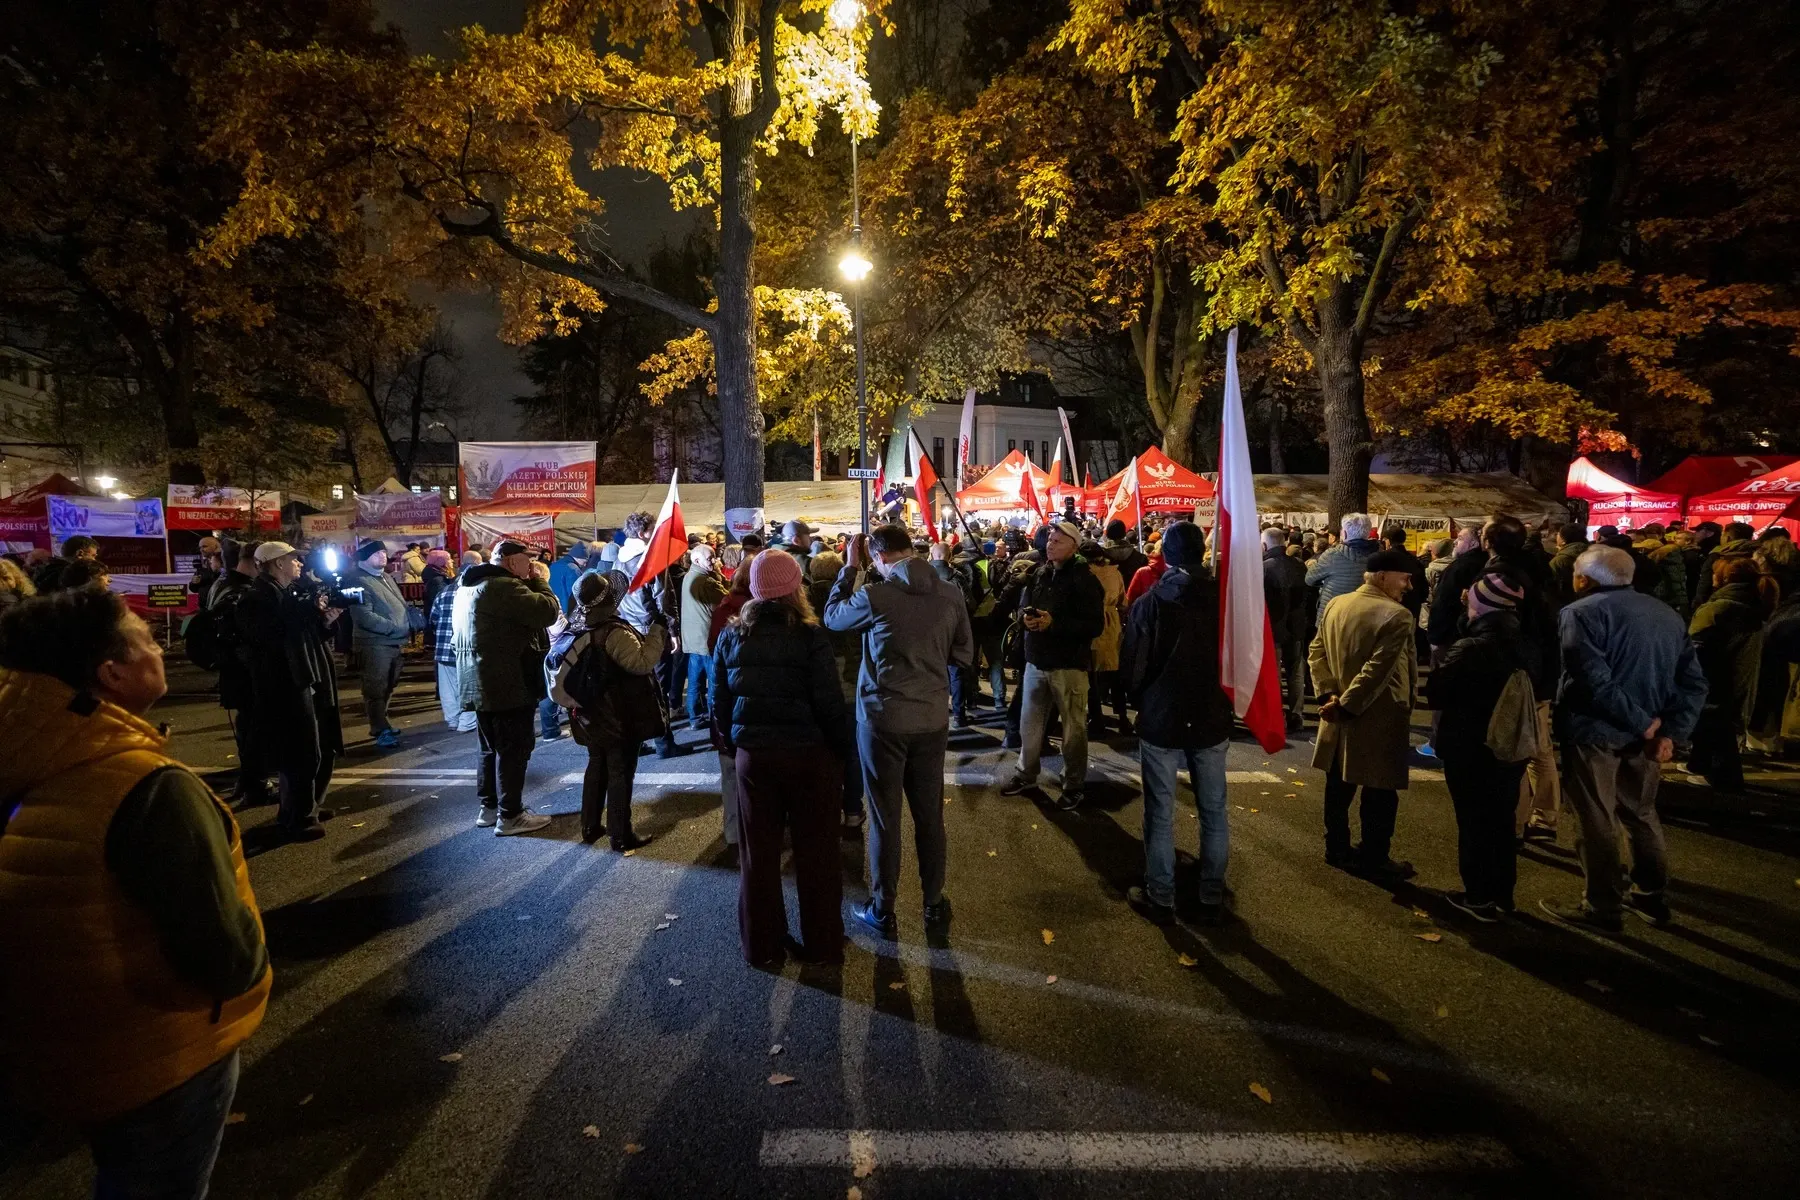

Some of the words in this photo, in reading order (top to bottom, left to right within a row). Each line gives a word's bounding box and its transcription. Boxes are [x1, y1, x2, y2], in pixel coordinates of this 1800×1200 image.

[534, 461, 559, 470] KLUB
[506, 471, 542, 480] GAZETY
[545, 471, 588, 480] POLSKIEJ
[506, 481, 588, 491] KIELCE-CENTRUM
[1146, 497, 1182, 505] GAZETY
[178, 511, 186, 520] TO
[1416, 519, 1445, 530] POLSKA
